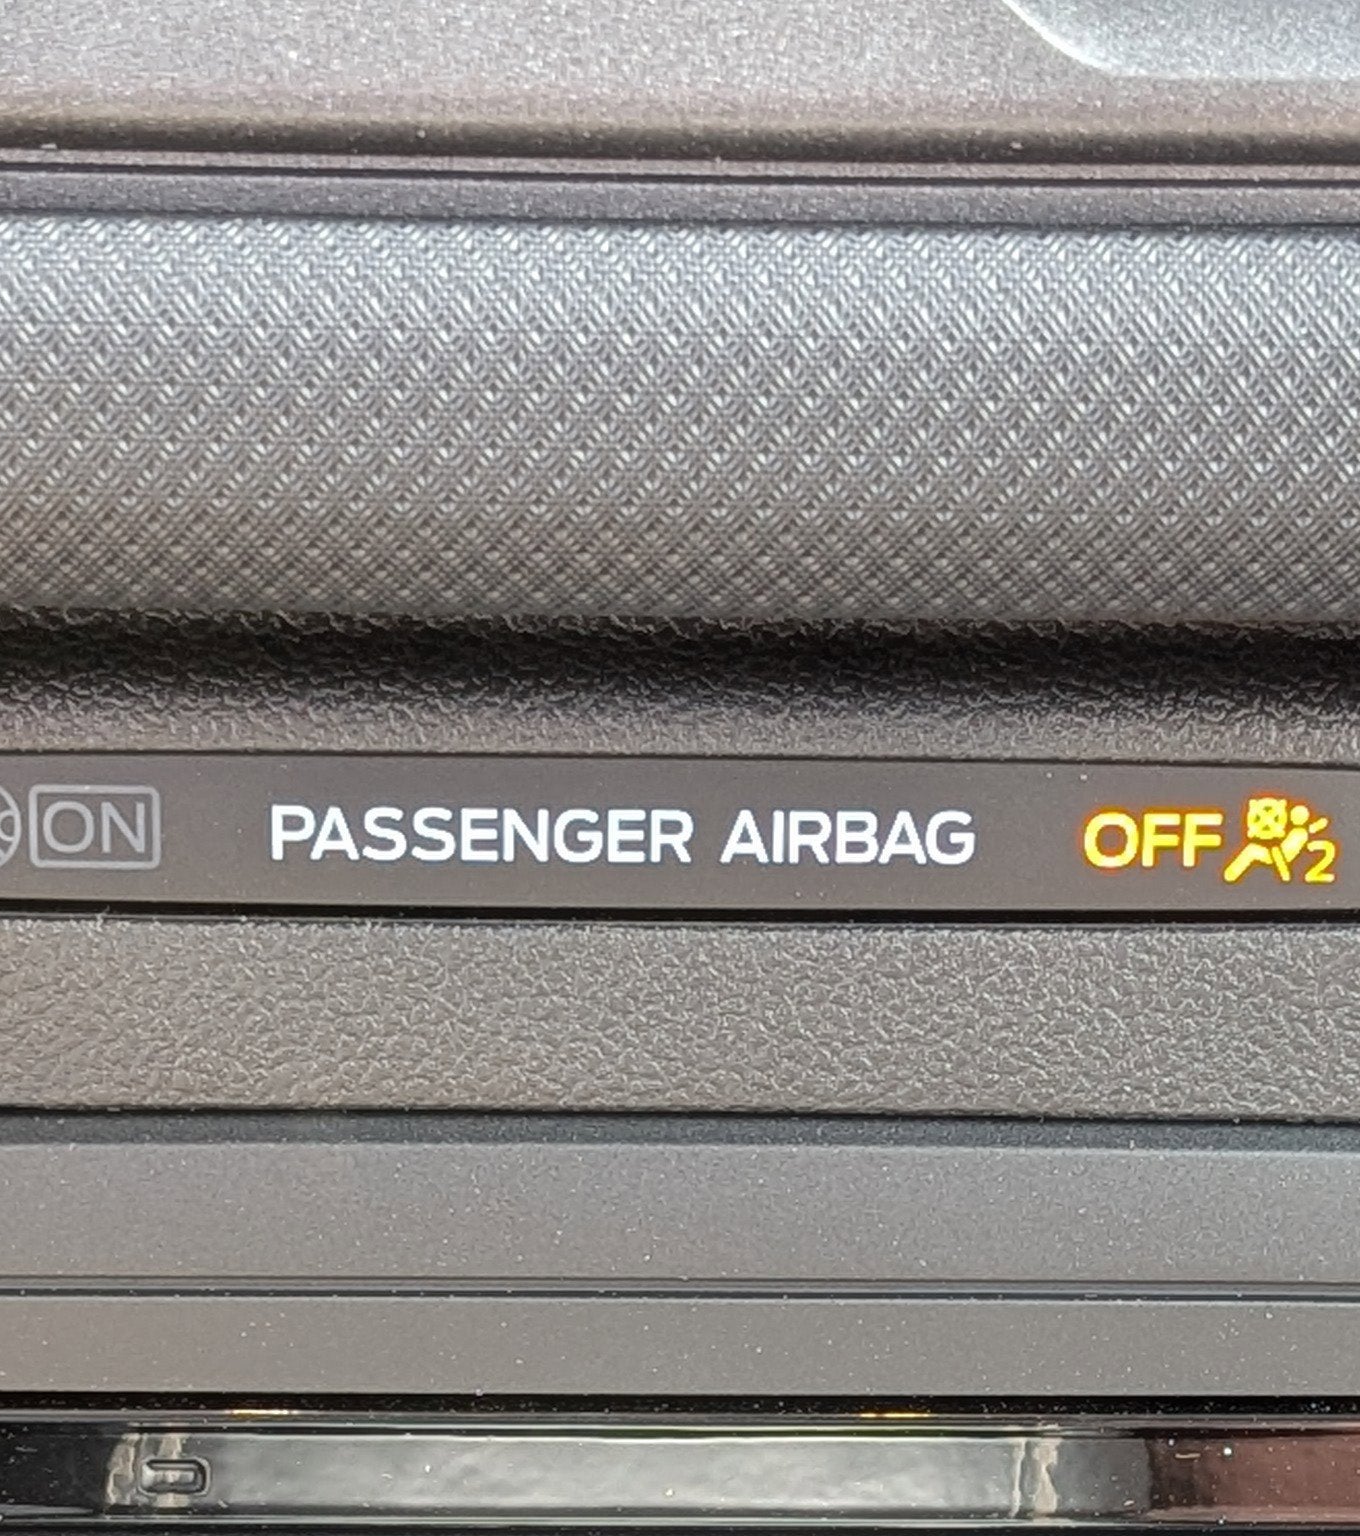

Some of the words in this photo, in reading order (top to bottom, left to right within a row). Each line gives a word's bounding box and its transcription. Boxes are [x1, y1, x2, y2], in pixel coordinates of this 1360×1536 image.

[43, 801, 146, 853] ON
[270, 803, 695, 865] PASSENGER
[719, 809, 976, 866] AIRBAG
[1083, 811, 1224, 868] OFF
